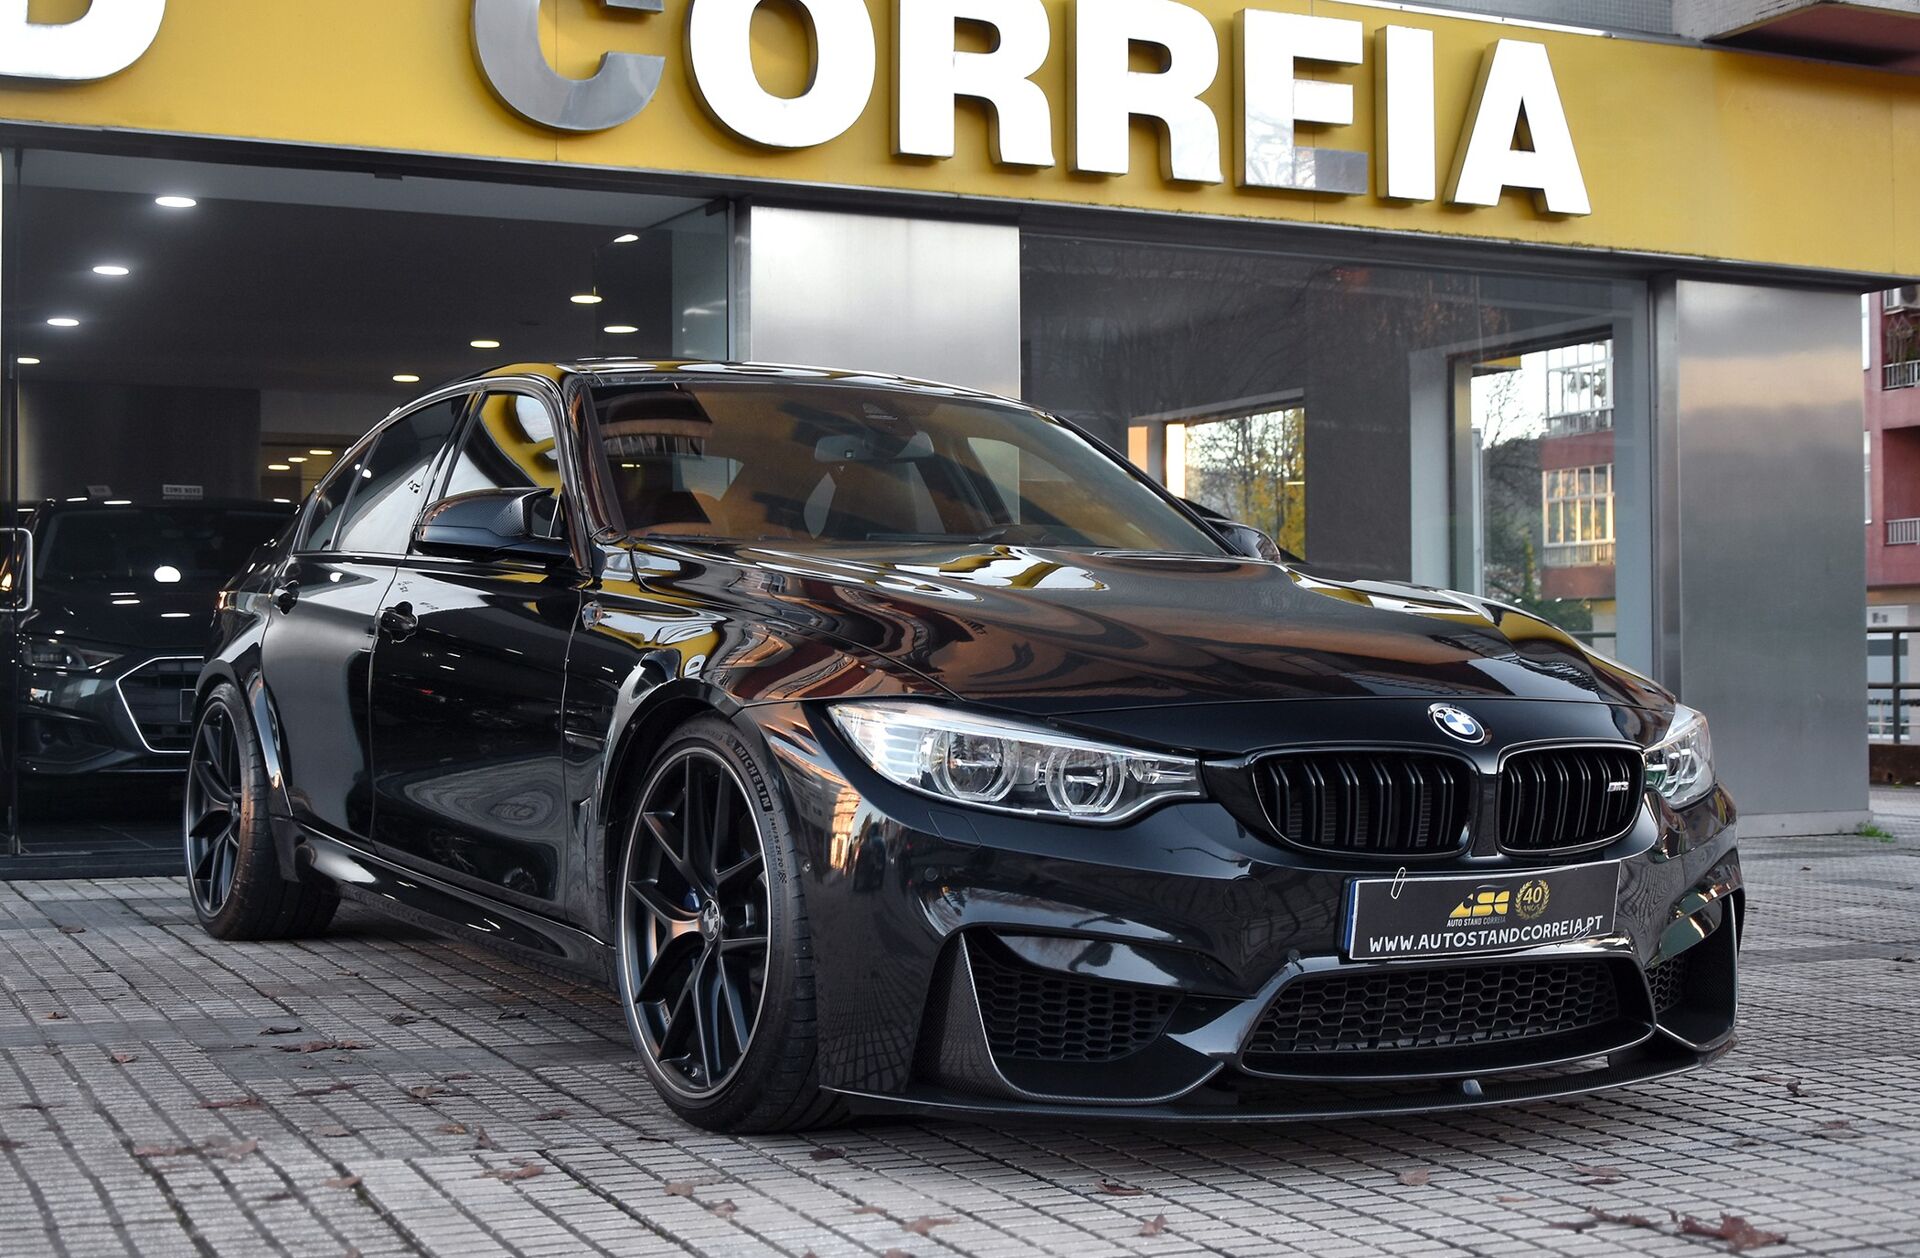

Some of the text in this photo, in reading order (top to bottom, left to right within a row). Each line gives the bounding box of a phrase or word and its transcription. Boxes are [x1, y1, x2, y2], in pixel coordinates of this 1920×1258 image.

[471, 0, 1592, 216] CORREIA
[736, 746, 771, 808] MICHELIN
[777, 857, 784, 867] 20
[1523, 886, 1543, 904] 40
[1369, 915, 1603, 953] WWW.AUTOSTANDCORREIA.PT
[1446, 916, 1506, 928] AUTO STAND CORREIA
